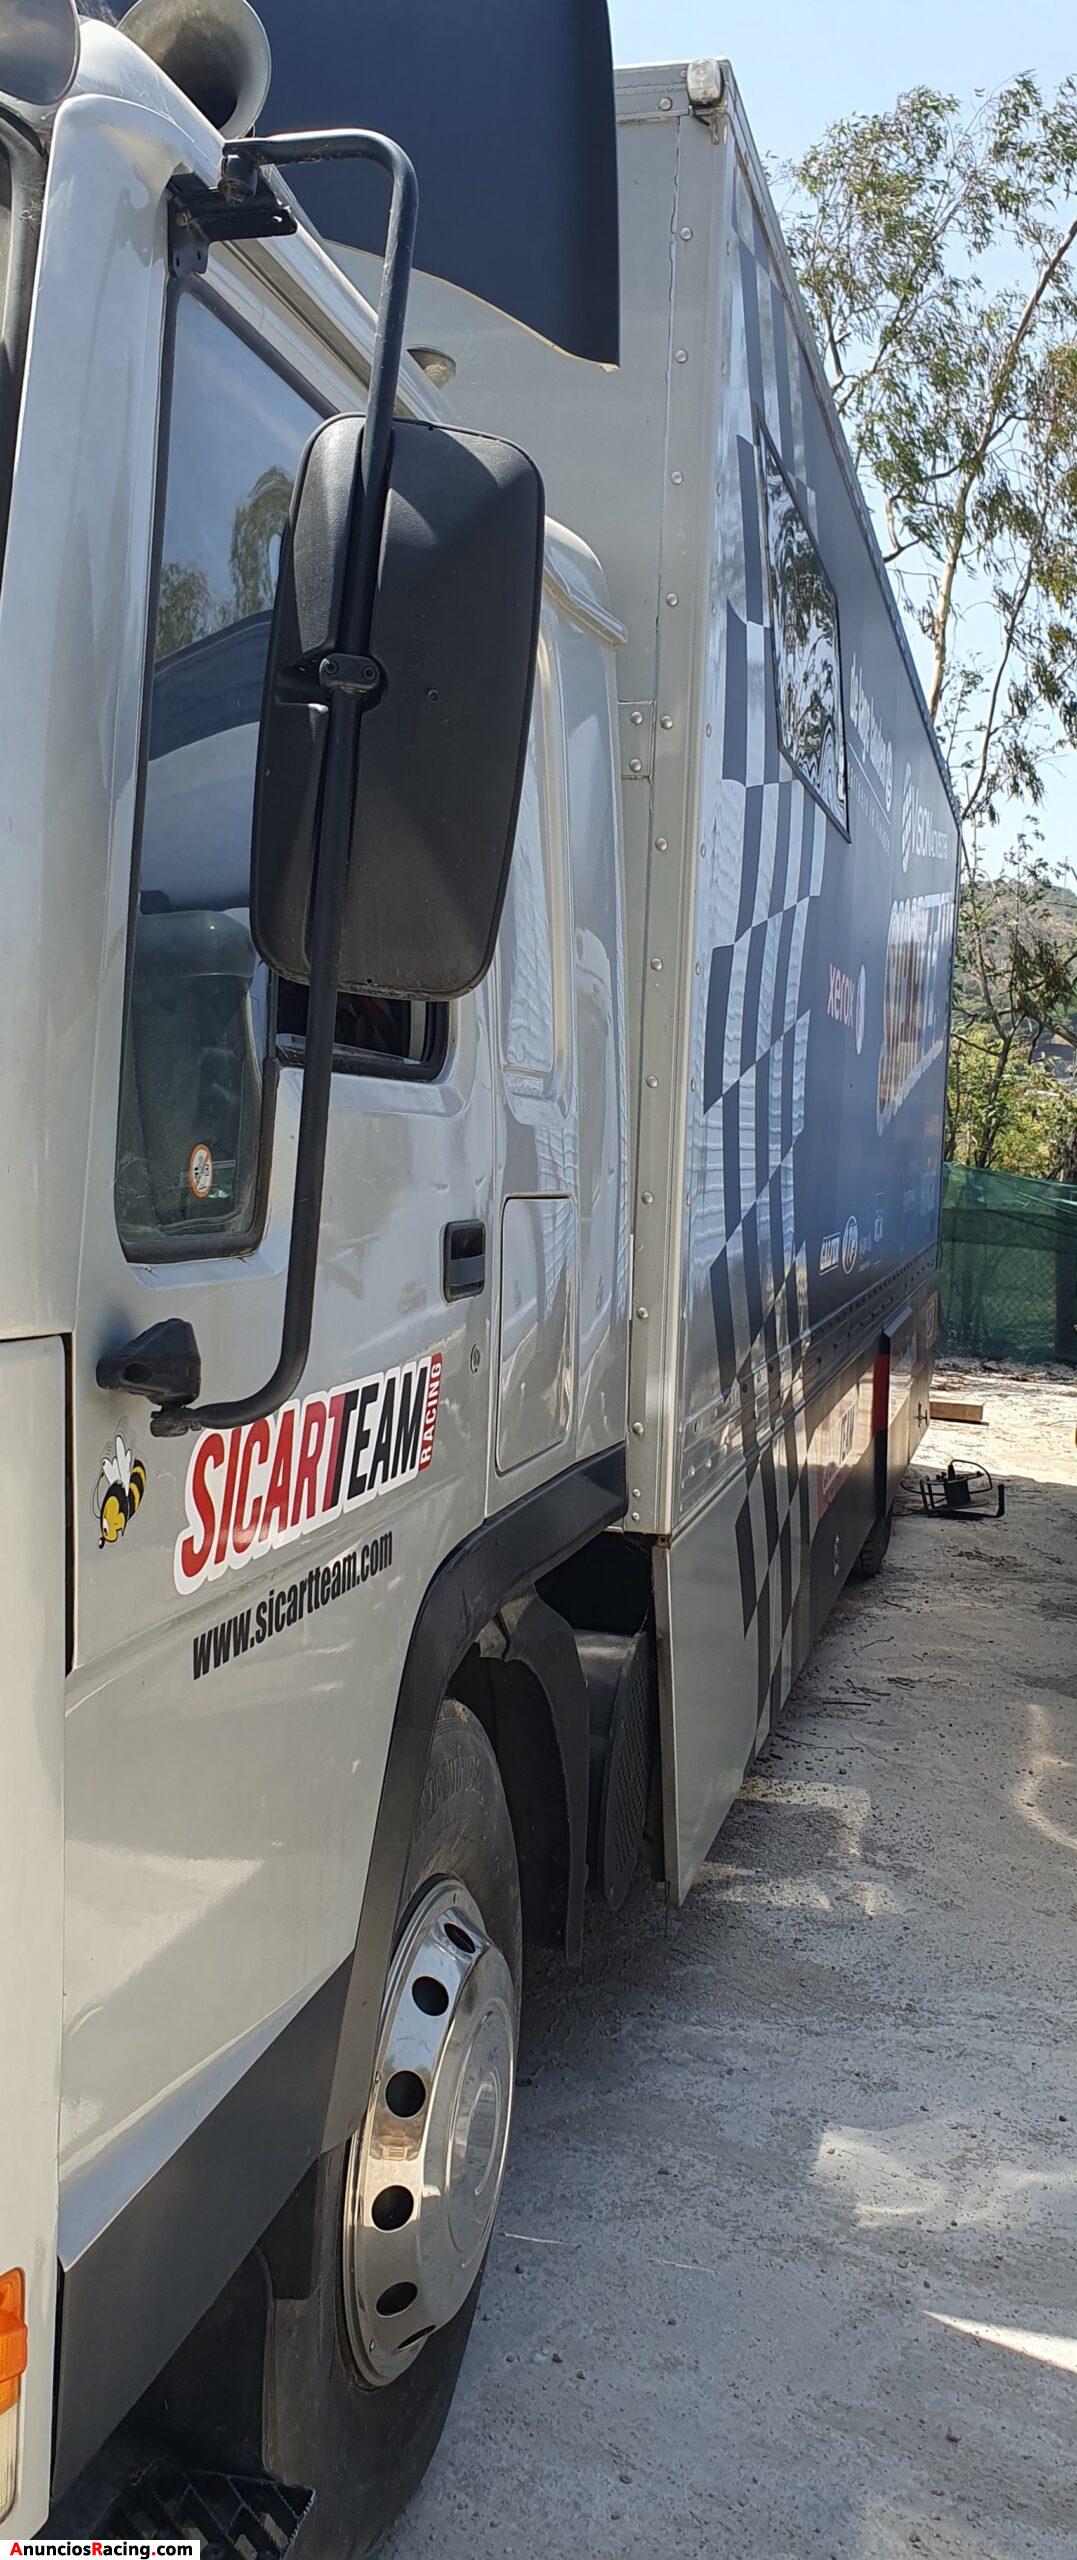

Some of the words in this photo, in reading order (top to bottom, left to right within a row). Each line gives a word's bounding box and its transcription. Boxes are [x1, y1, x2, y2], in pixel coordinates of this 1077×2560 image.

[827, 963, 855, 1029] xerox
[181, 1366, 428, 1577] SICARTEAM
[420, 1362, 442, 1465] RACING
[193, 1530, 393, 1680] www.sicartteam.com
